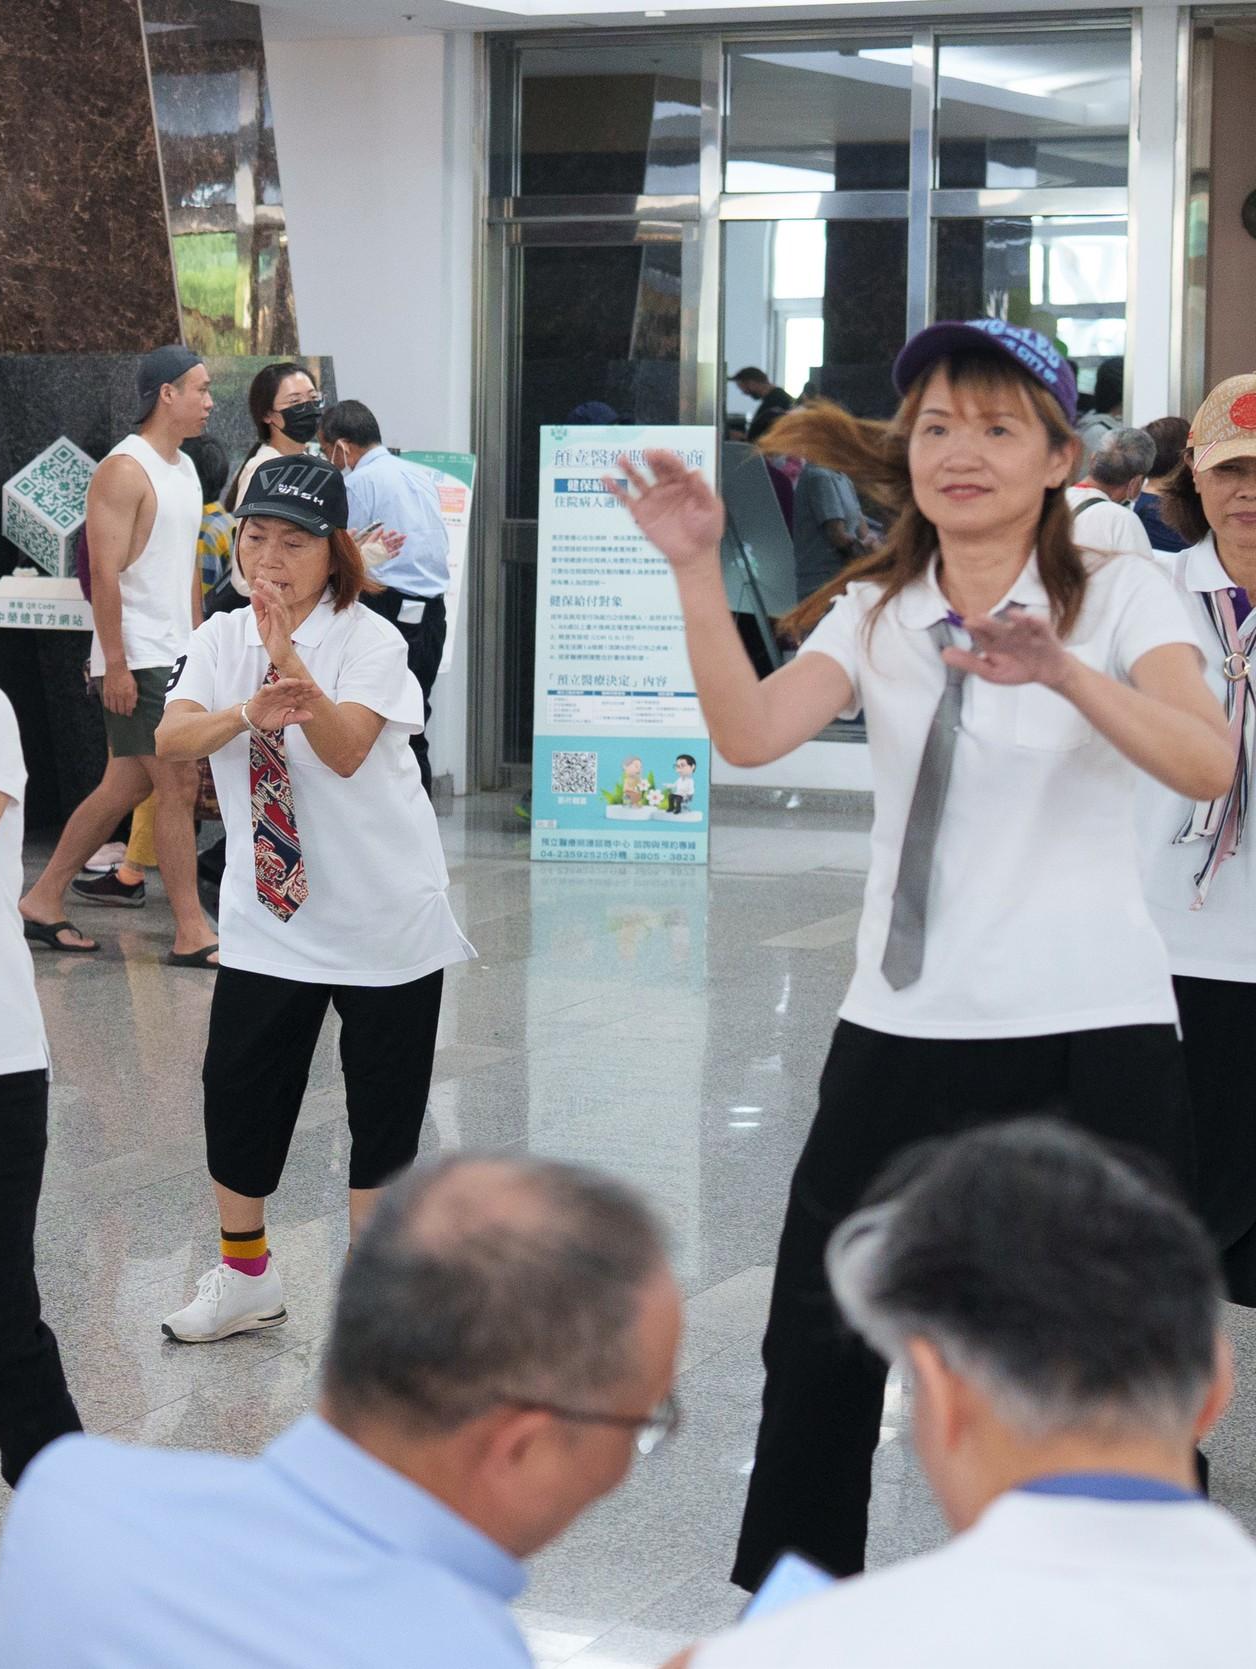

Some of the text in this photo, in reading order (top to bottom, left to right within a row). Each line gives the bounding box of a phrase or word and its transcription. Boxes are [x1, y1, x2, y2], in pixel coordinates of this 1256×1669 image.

[550, 595, 622, 607] 健保給付對象
